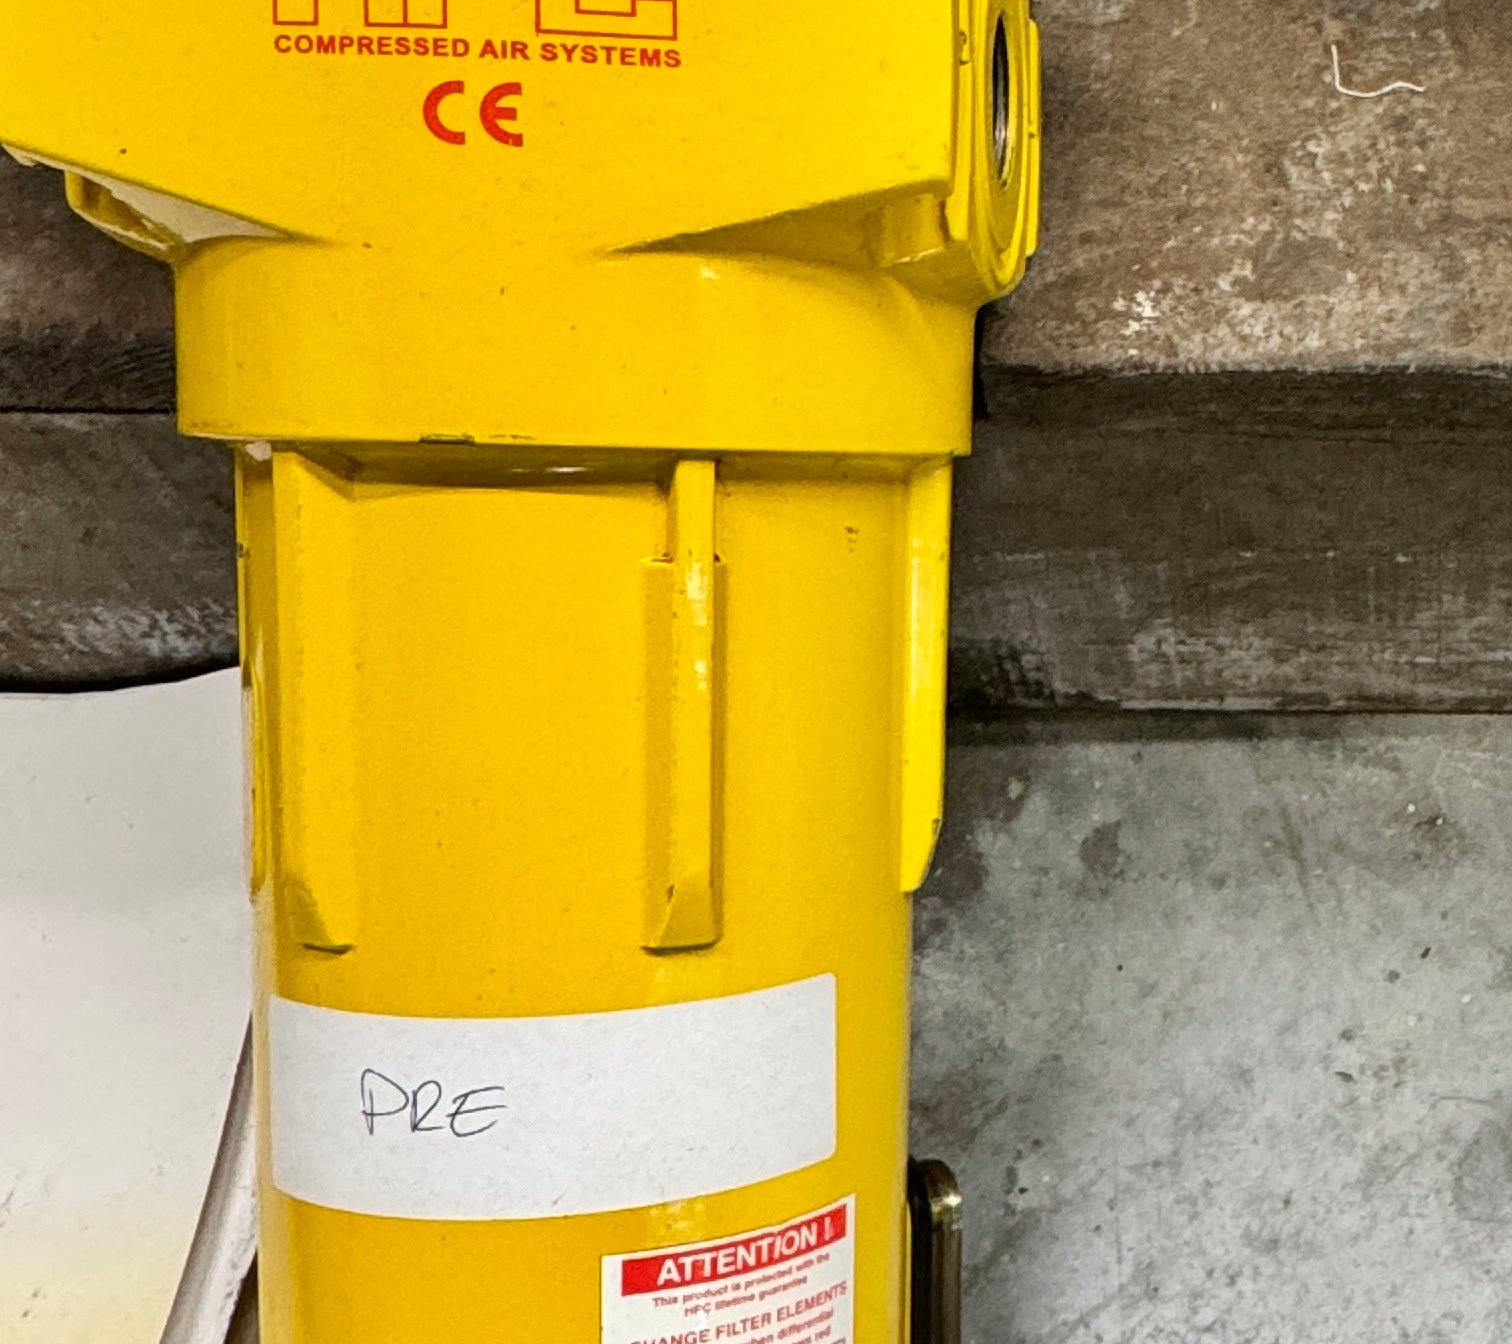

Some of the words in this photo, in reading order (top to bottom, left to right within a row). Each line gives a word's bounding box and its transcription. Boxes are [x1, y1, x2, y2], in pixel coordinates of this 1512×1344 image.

[274, 33, 470, 58] COMPRESSED
[478, 39, 531, 61] AIR
[540, 42, 682, 69] SYSTEMS
[422, 79, 524, 147] CE
[361, 1068, 508, 1138] PRE
[657, 1221, 817, 1286] ATTENTION
[652, 1296, 678, 1309] This
[683, 1284, 728, 1305] product
[684, 1302, 712, 1318] HPC
[716, 1312, 772, 1341] FILTER
[776, 1280, 848, 1322] ELEMENTS
[777, 1307, 834, 1340] differential
[815, 1324, 832, 1342] red
